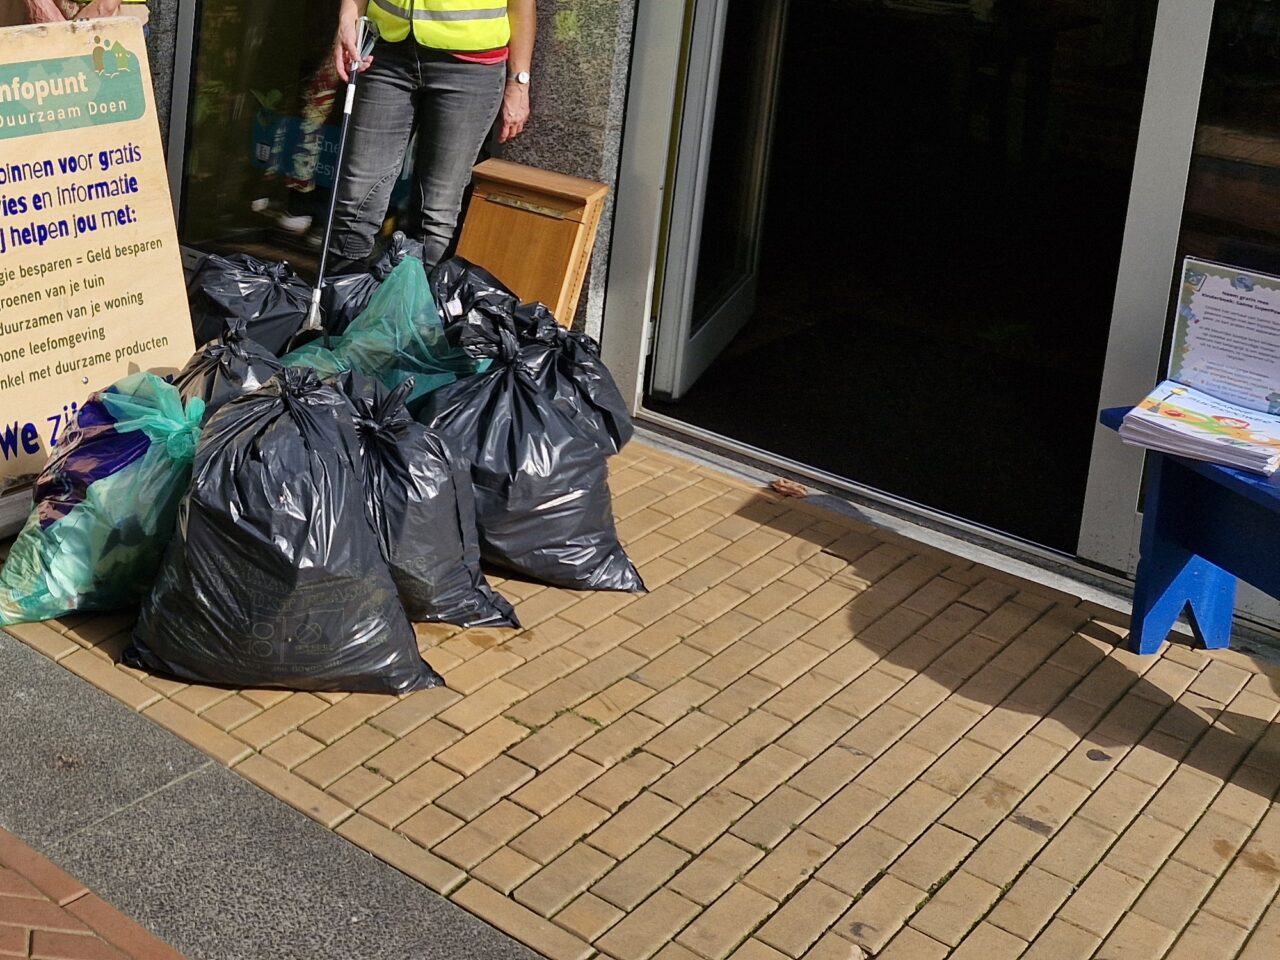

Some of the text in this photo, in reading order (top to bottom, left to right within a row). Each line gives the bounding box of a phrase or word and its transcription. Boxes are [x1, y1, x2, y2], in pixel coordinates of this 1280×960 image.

[88, 99, 127, 115] Doen
[58, 153, 94, 174] voor
[98, 142, 142, 172] gratis
[32, 191, 53, 211] en
[56, 173, 139, 205] informatie
[10, 220, 69, 246] helpen
[73, 213, 97, 238] jou
[101, 204, 137, 228] met:
[19, 256, 73, 279] besparen
[87, 247, 112, 265] Geld
[115, 237, 163, 258] besparen
[45, 283, 67, 299] van
[69, 279, 80, 297] je
[83, 273, 106, 290] tuin
[66, 305, 88, 320] van
[90, 299, 102, 318] je
[104, 290, 145, 312] woning
[28, 324, 107, 354] leefomgeving
[29, 365, 52, 382] met
[55, 350, 112, 375] duurzame
[115, 334, 169, 362] producten
